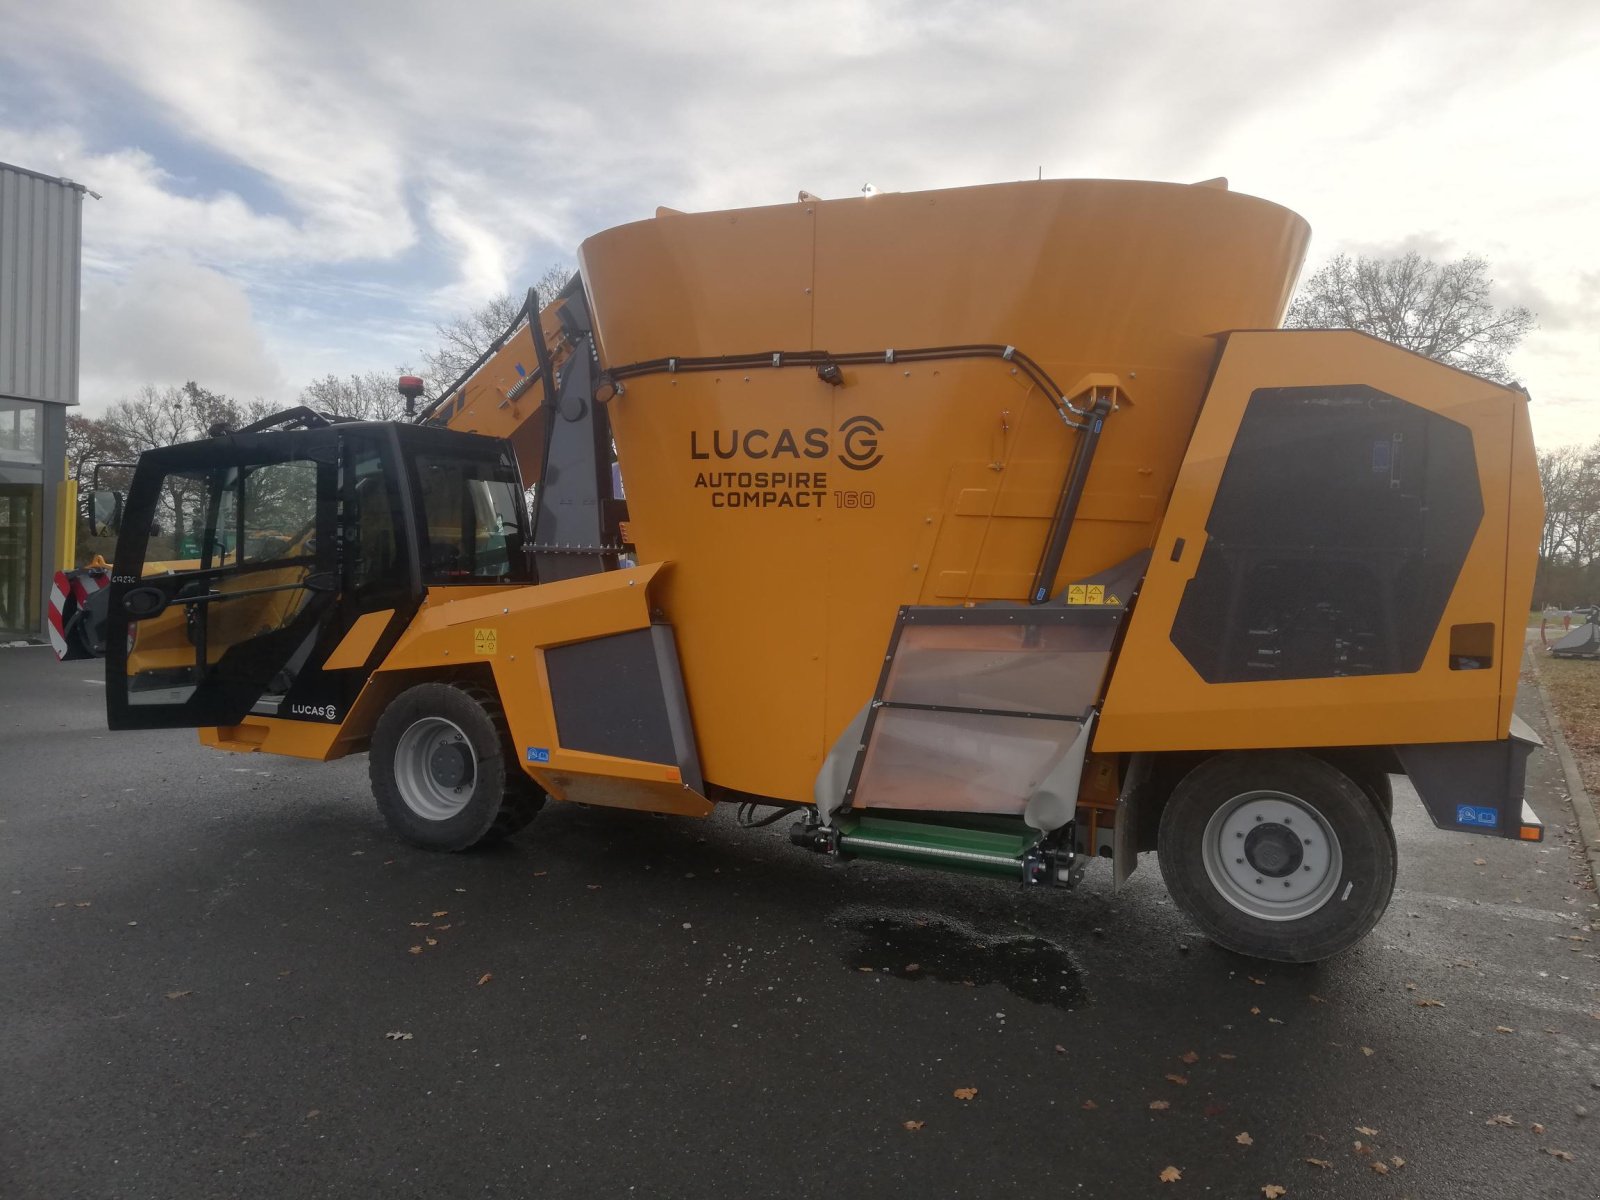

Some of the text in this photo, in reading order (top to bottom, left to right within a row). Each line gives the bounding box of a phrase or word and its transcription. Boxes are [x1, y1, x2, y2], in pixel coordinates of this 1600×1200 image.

[691, 428, 829, 460] LUCAS
[694, 472, 827, 489] AUTOSPIRE
[712, 490, 875, 509] COMPACT 160
[292, 704, 325, 716] LUCAS
